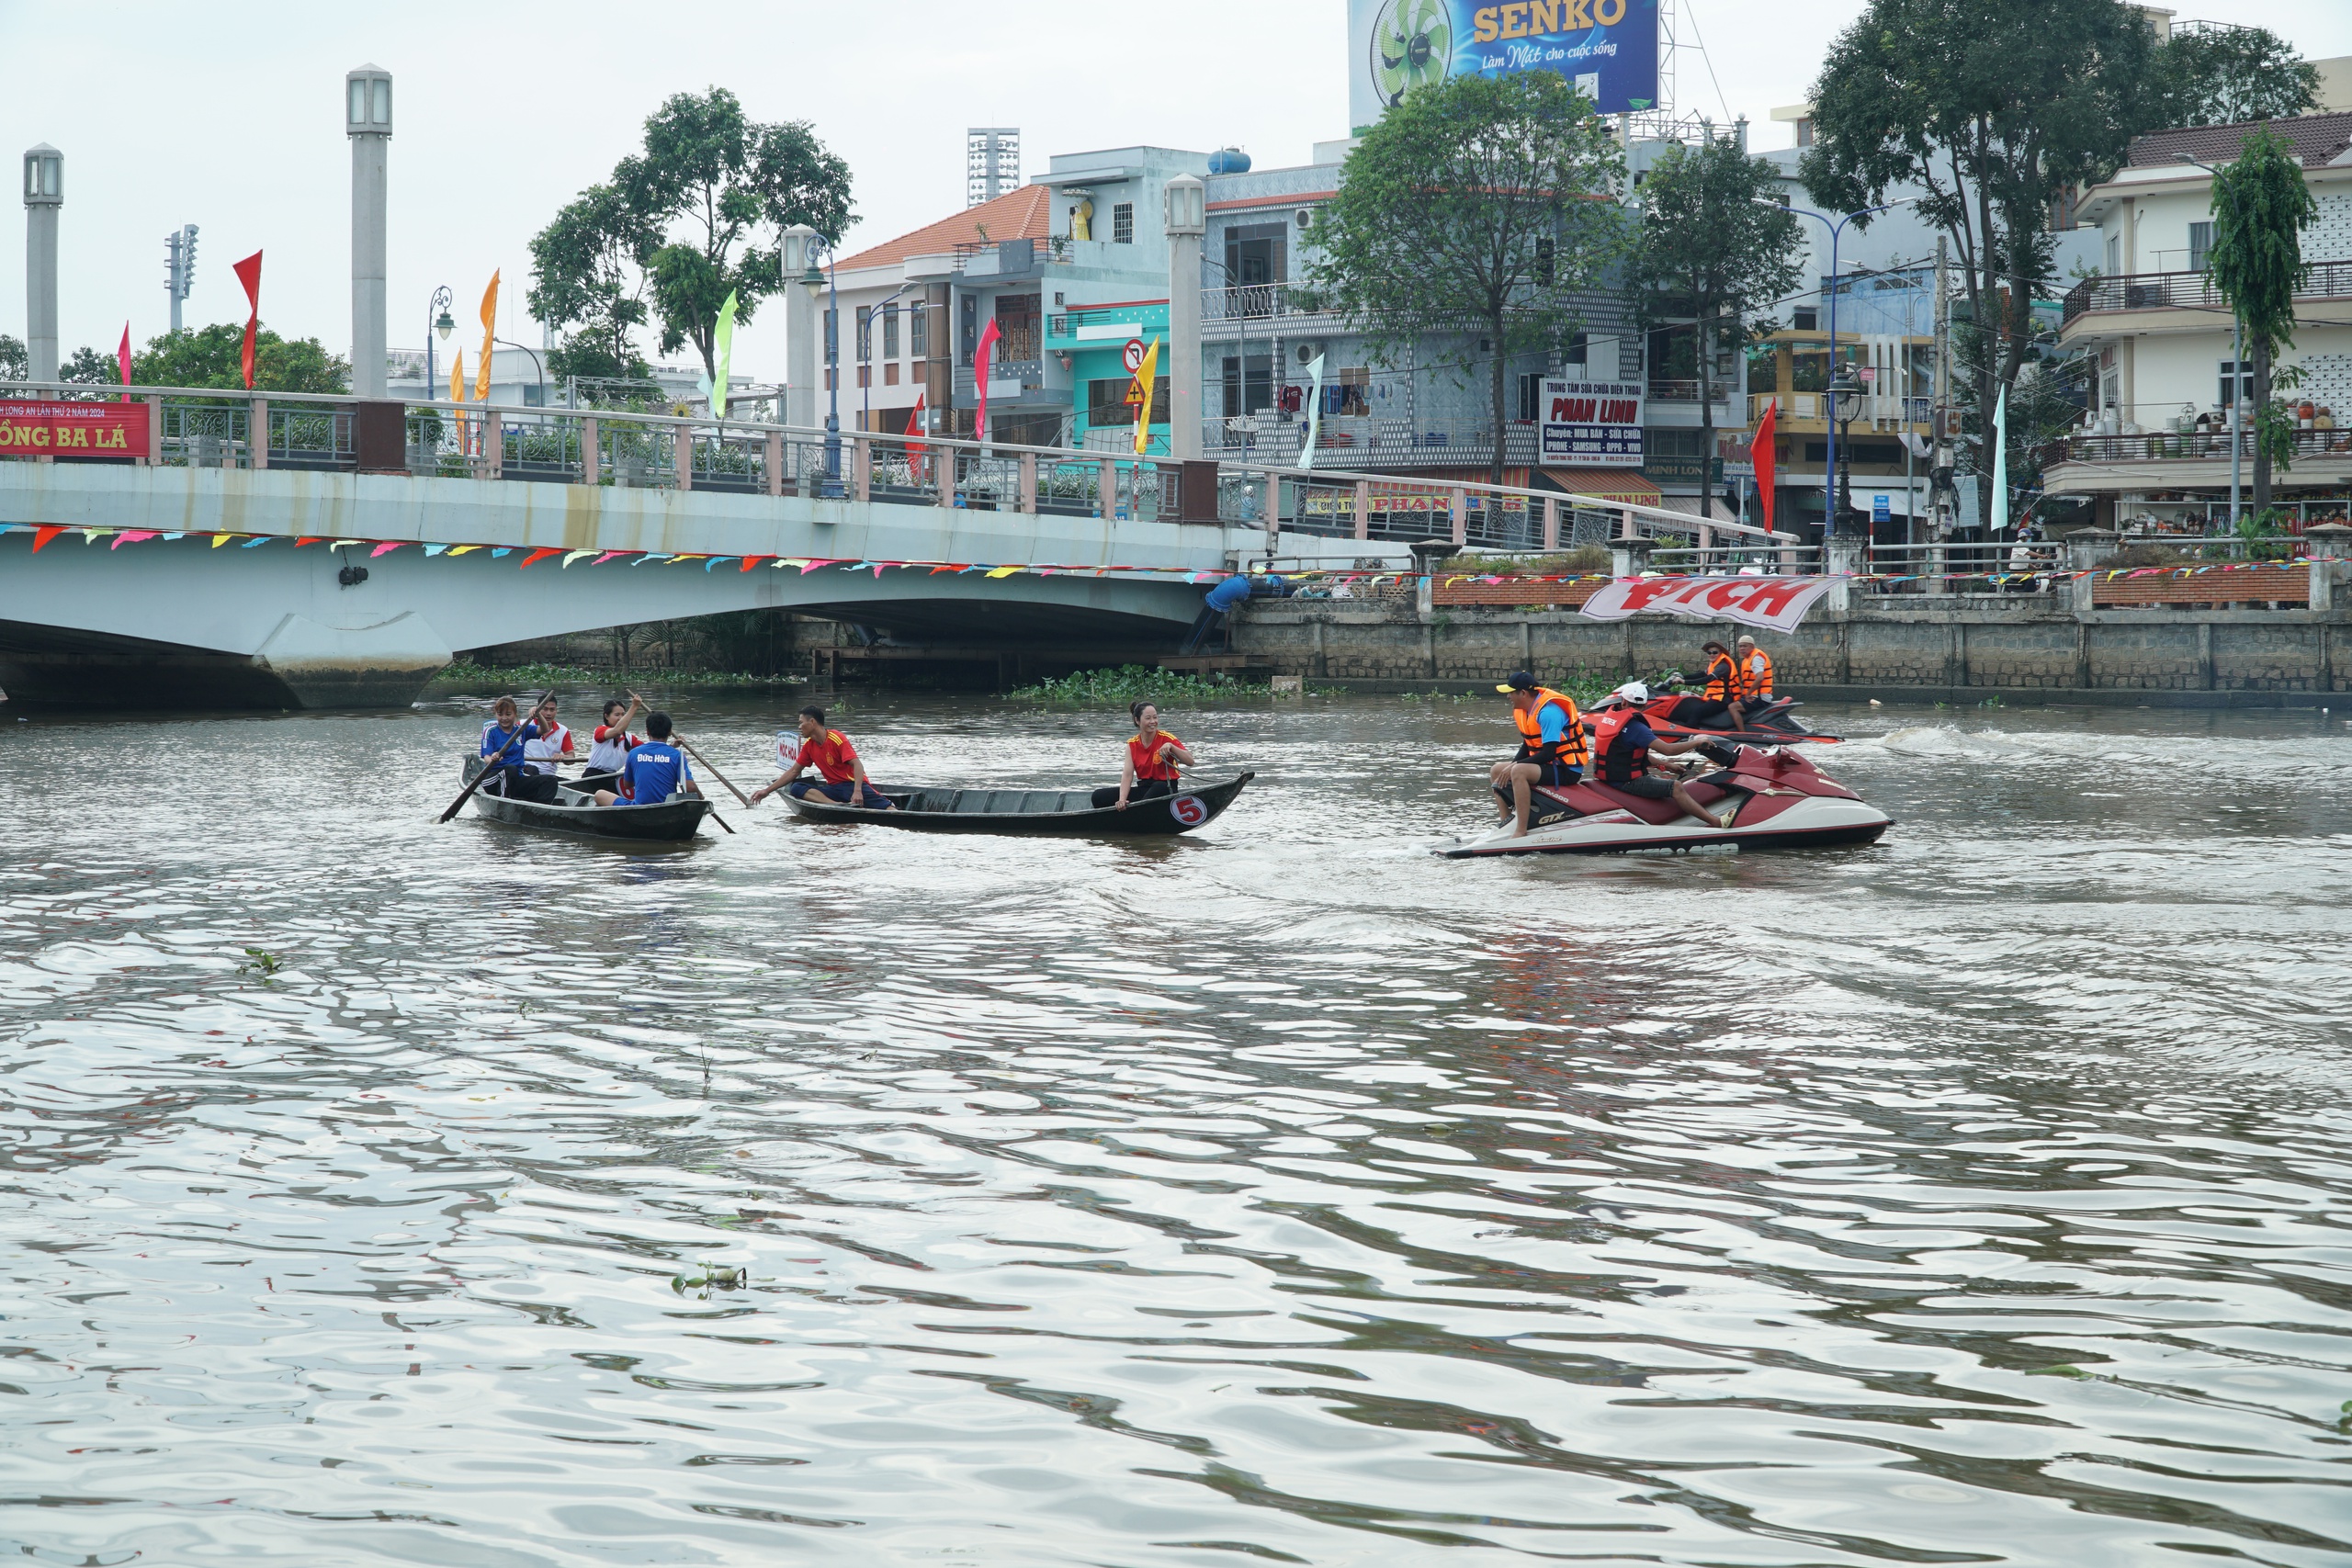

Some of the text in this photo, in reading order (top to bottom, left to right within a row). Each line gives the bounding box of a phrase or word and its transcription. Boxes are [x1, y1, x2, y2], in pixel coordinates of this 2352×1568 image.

[1474, 0, 1626, 42] SENKO
[1482, 40, 1617, 69] Làm Mát cho cuộc sống
[1547, 383, 1566, 393] TRUNG
[1567, 382, 1579, 394] TÂM
[5, 406, 24, 415] LONG
[25, 406, 36, 416] AN
[66, 408, 70, 417] 2
[72, 406, 88, 417] NĂM
[90, 408, 105, 417] 2024
[1550, 397, 1638, 424] PHAN LINH
[57, 427, 89, 447] BA
[95, 423, 127, 448] LÁ
[1574, 429, 1589, 439] MUA
[1590, 427, 1603, 439] BÁN
[1546, 441, 1568, 451] IPHONE
[1572, 442, 1601, 451] SAMSUNG
[1606, 442, 1622, 452] OPPO
[1628, 443, 1641, 452] VIVO
[1645, 465, 1713, 475] MINH LON
[1374, 497, 1450, 511] PHAN
[654, 754, 670, 763] Hòa
[1176, 797, 1201, 822] 5
